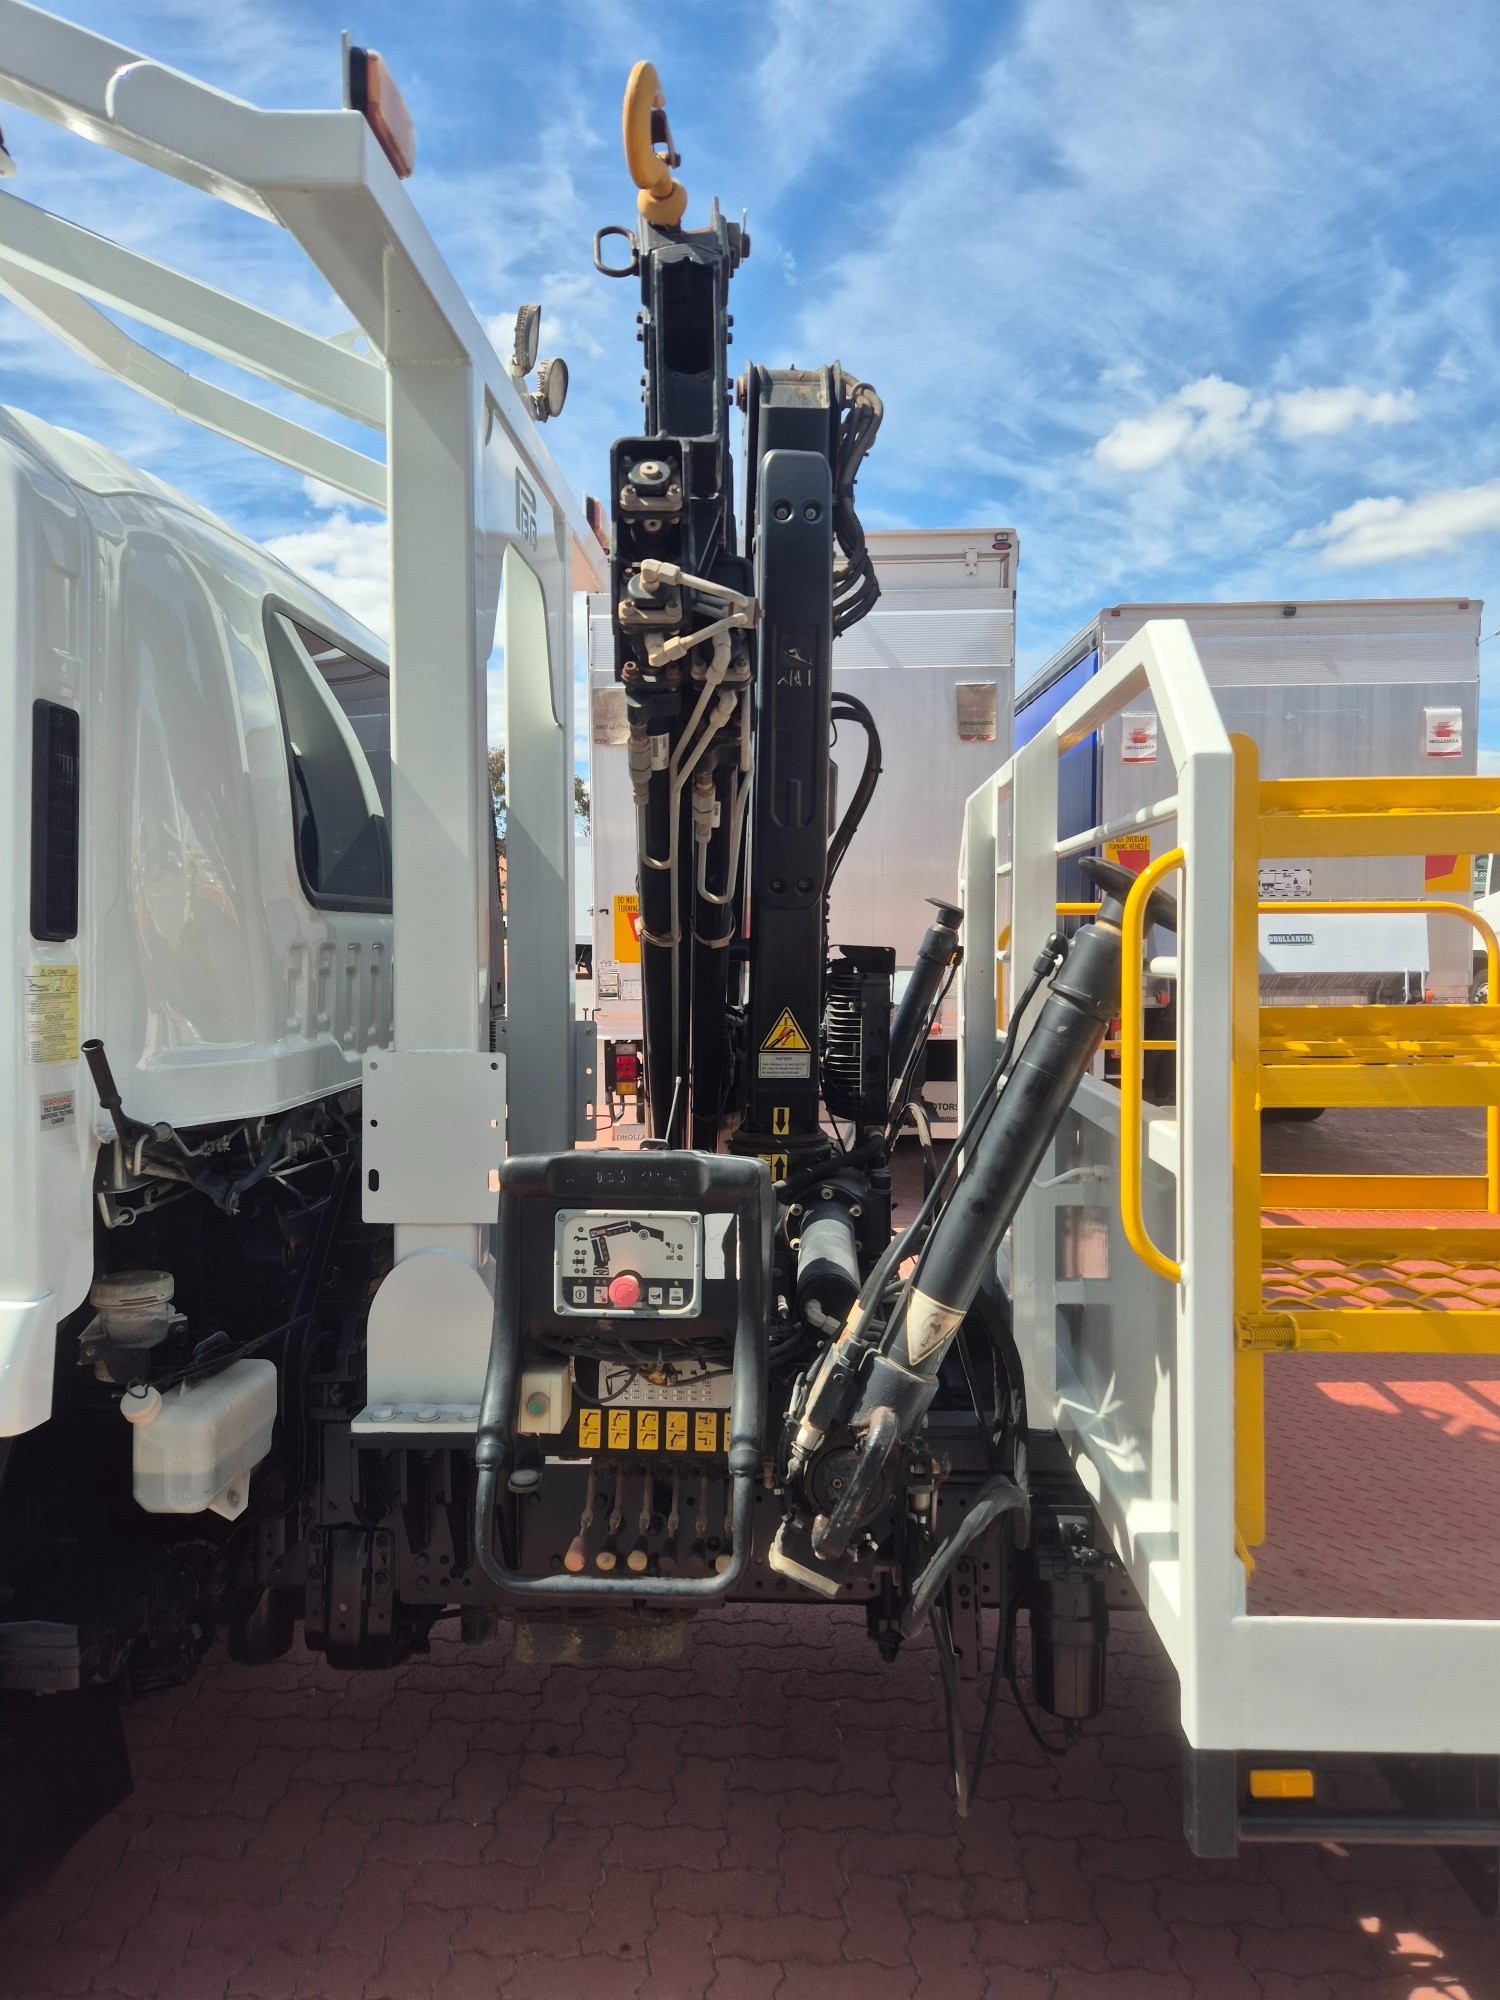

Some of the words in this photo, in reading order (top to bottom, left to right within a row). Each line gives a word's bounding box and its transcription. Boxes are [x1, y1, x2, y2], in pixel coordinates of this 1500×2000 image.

[1125, 835, 1148, 843] OVERTAKE
[617, 896, 625, 904] DO
[625, 896, 636, 904] NOT
[618, 904, 639, 912] TURNING
[1267, 935, 1314, 943] DHOLLANDIA
[43, 1094, 72, 1107] WARNING
[53, 1102, 72, 1111] BULLBAR
[41, 1111, 58, 1120] BEFORE
[59, 1108, 74, 1117] TILTING
